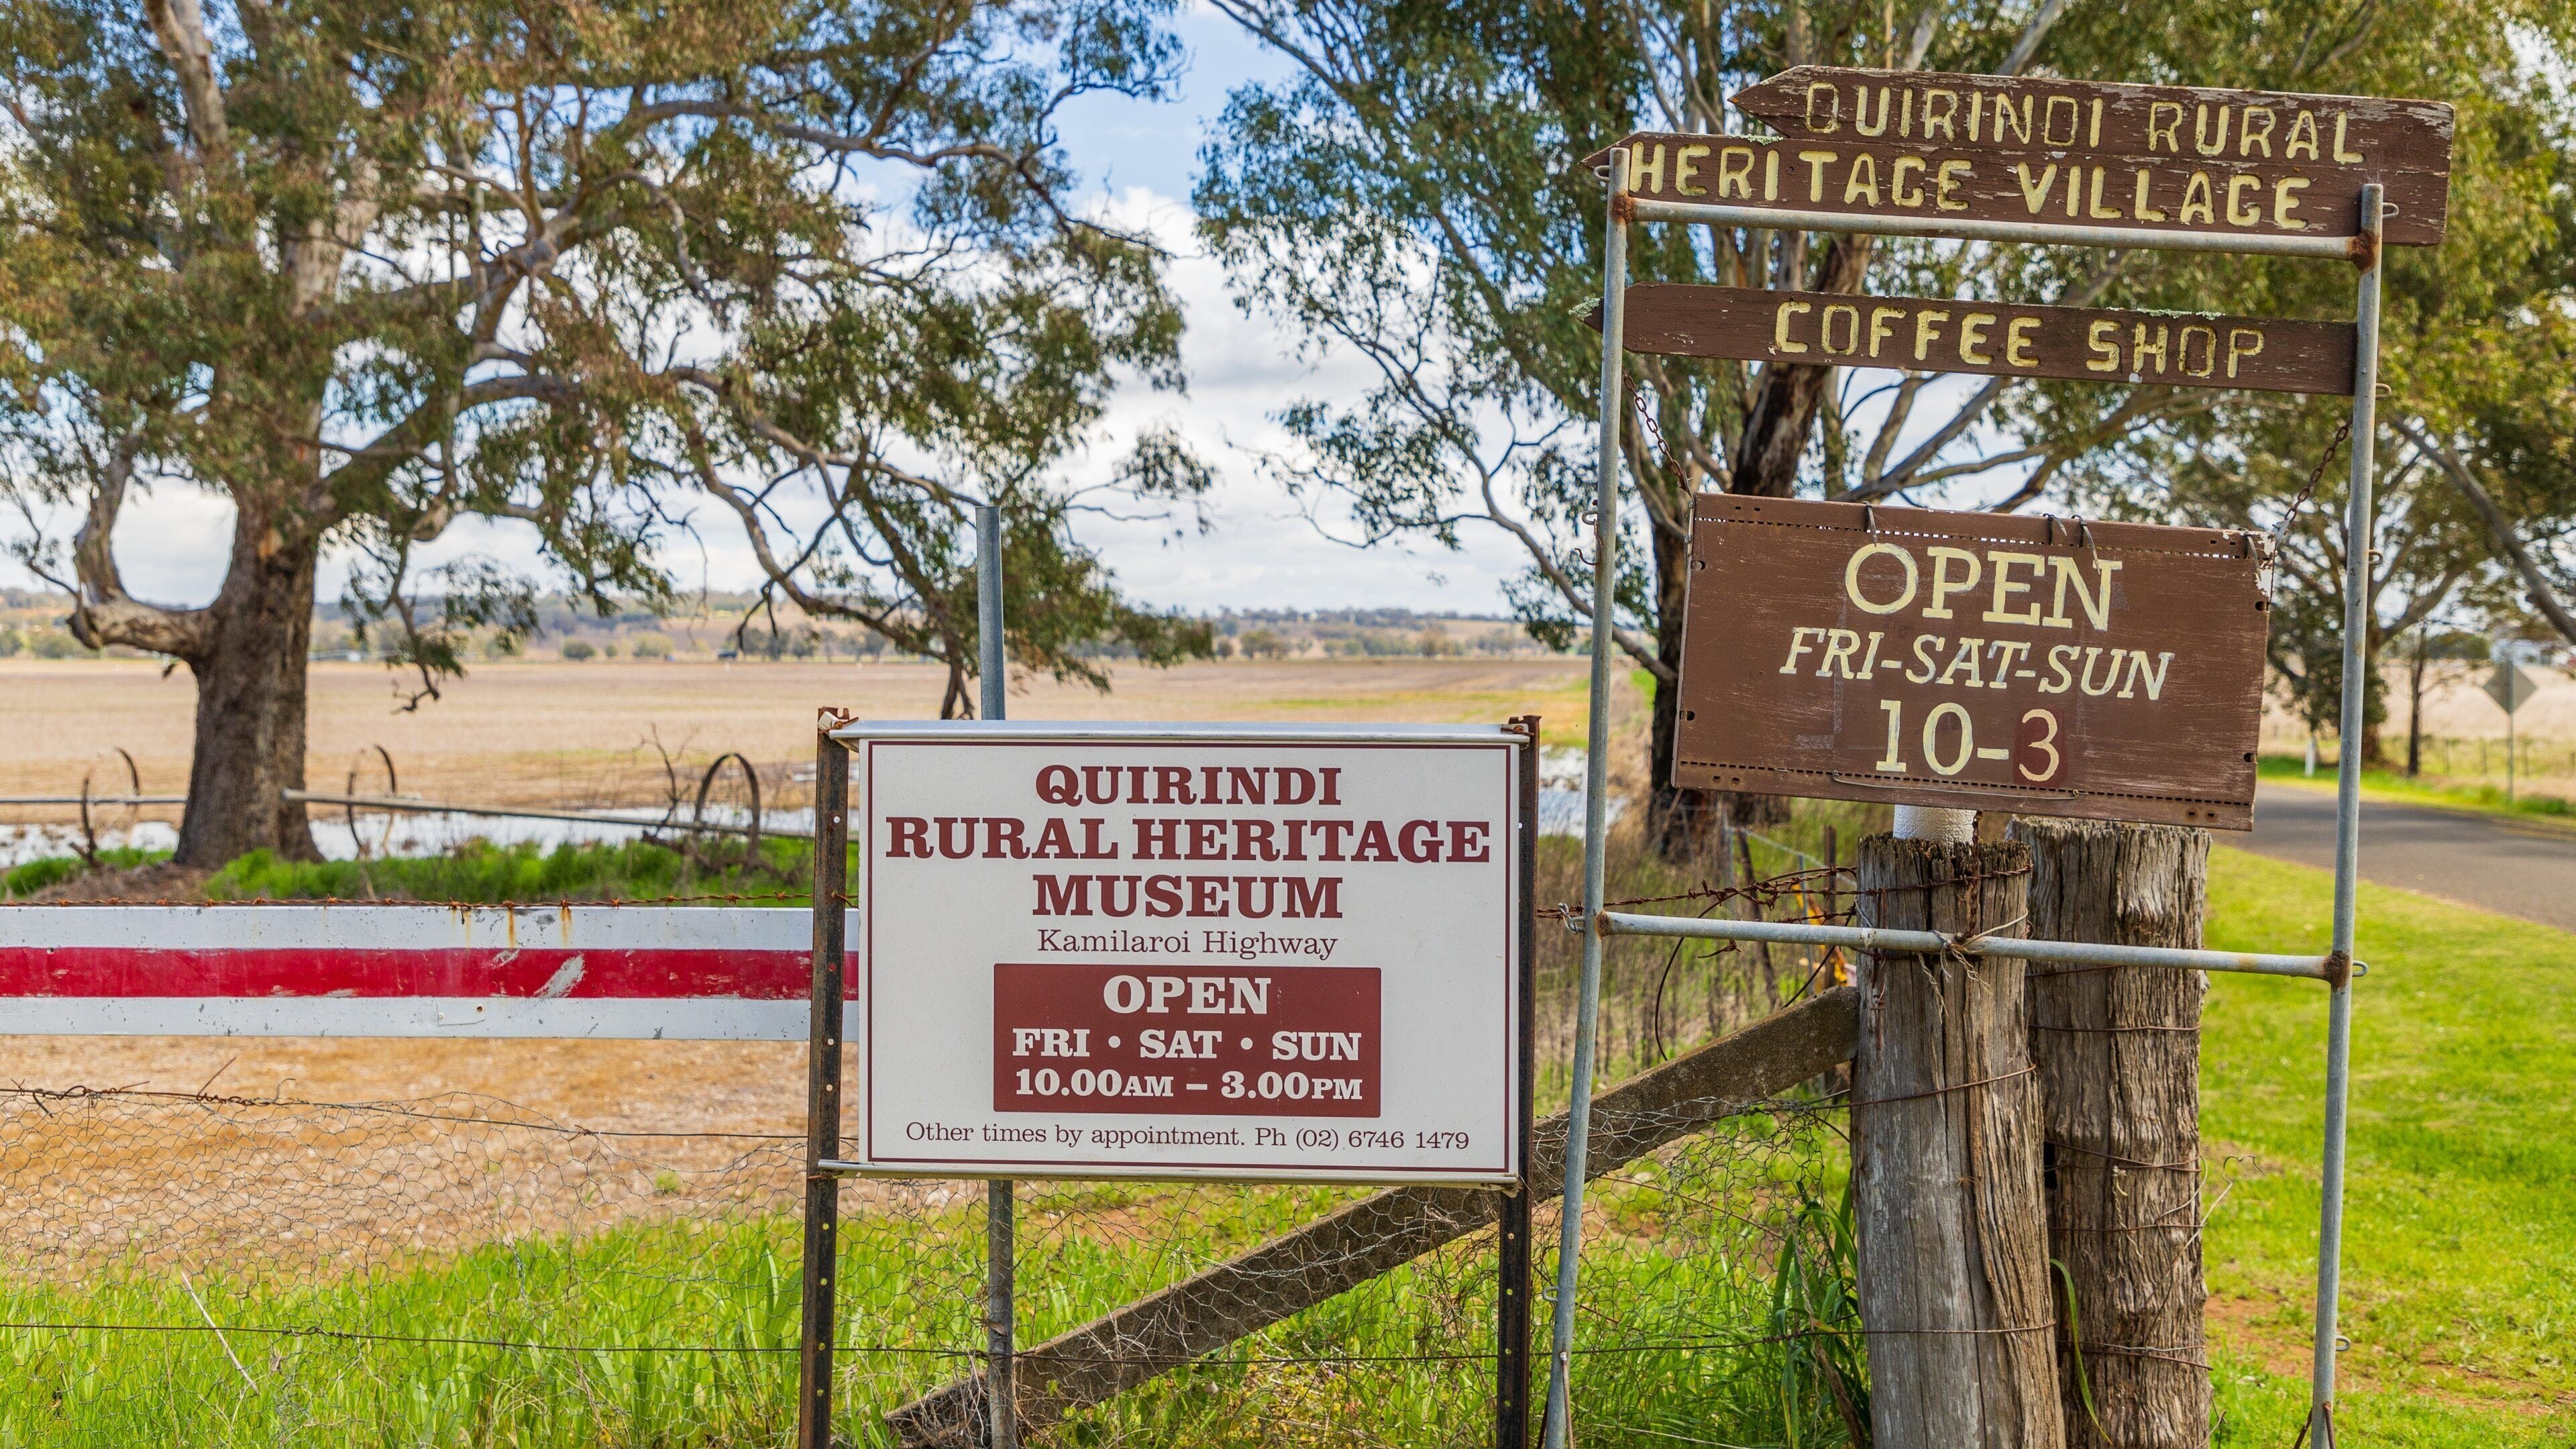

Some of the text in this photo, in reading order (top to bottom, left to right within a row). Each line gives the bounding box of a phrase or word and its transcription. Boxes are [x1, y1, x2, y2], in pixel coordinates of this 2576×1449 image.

[2148, 101, 2365, 164] RURAL
[1629, 141, 2312, 229] HERITAGE VILLAGE
[1775, 301, 2265, 378] COFFEE SHOP
[1844, 542, 2123, 631] OPEN
[1779, 627, 2175, 701] FRI-SAT-SUN
[1876, 699, 2060, 783] 10-3
[1035, 764, 1342, 807] QUIRINDI
[885, 816, 1490, 864] RURAL HERITAGE
[1032, 874, 1343, 919] MUSEUM
[1037, 929, 1338, 961] Kamilaroi Highway
[1104, 975, 1271, 1014] OPEN
[1012, 1028, 1362, 1061] FRI SAT SUN
[1016, 1068, 1174, 1097] 10.00AM
[1221, 1071, 1362, 1100] 3.00PM
[906, 1122, 1469, 1152] Other times by appointment. Ph (02) 6746 1479
